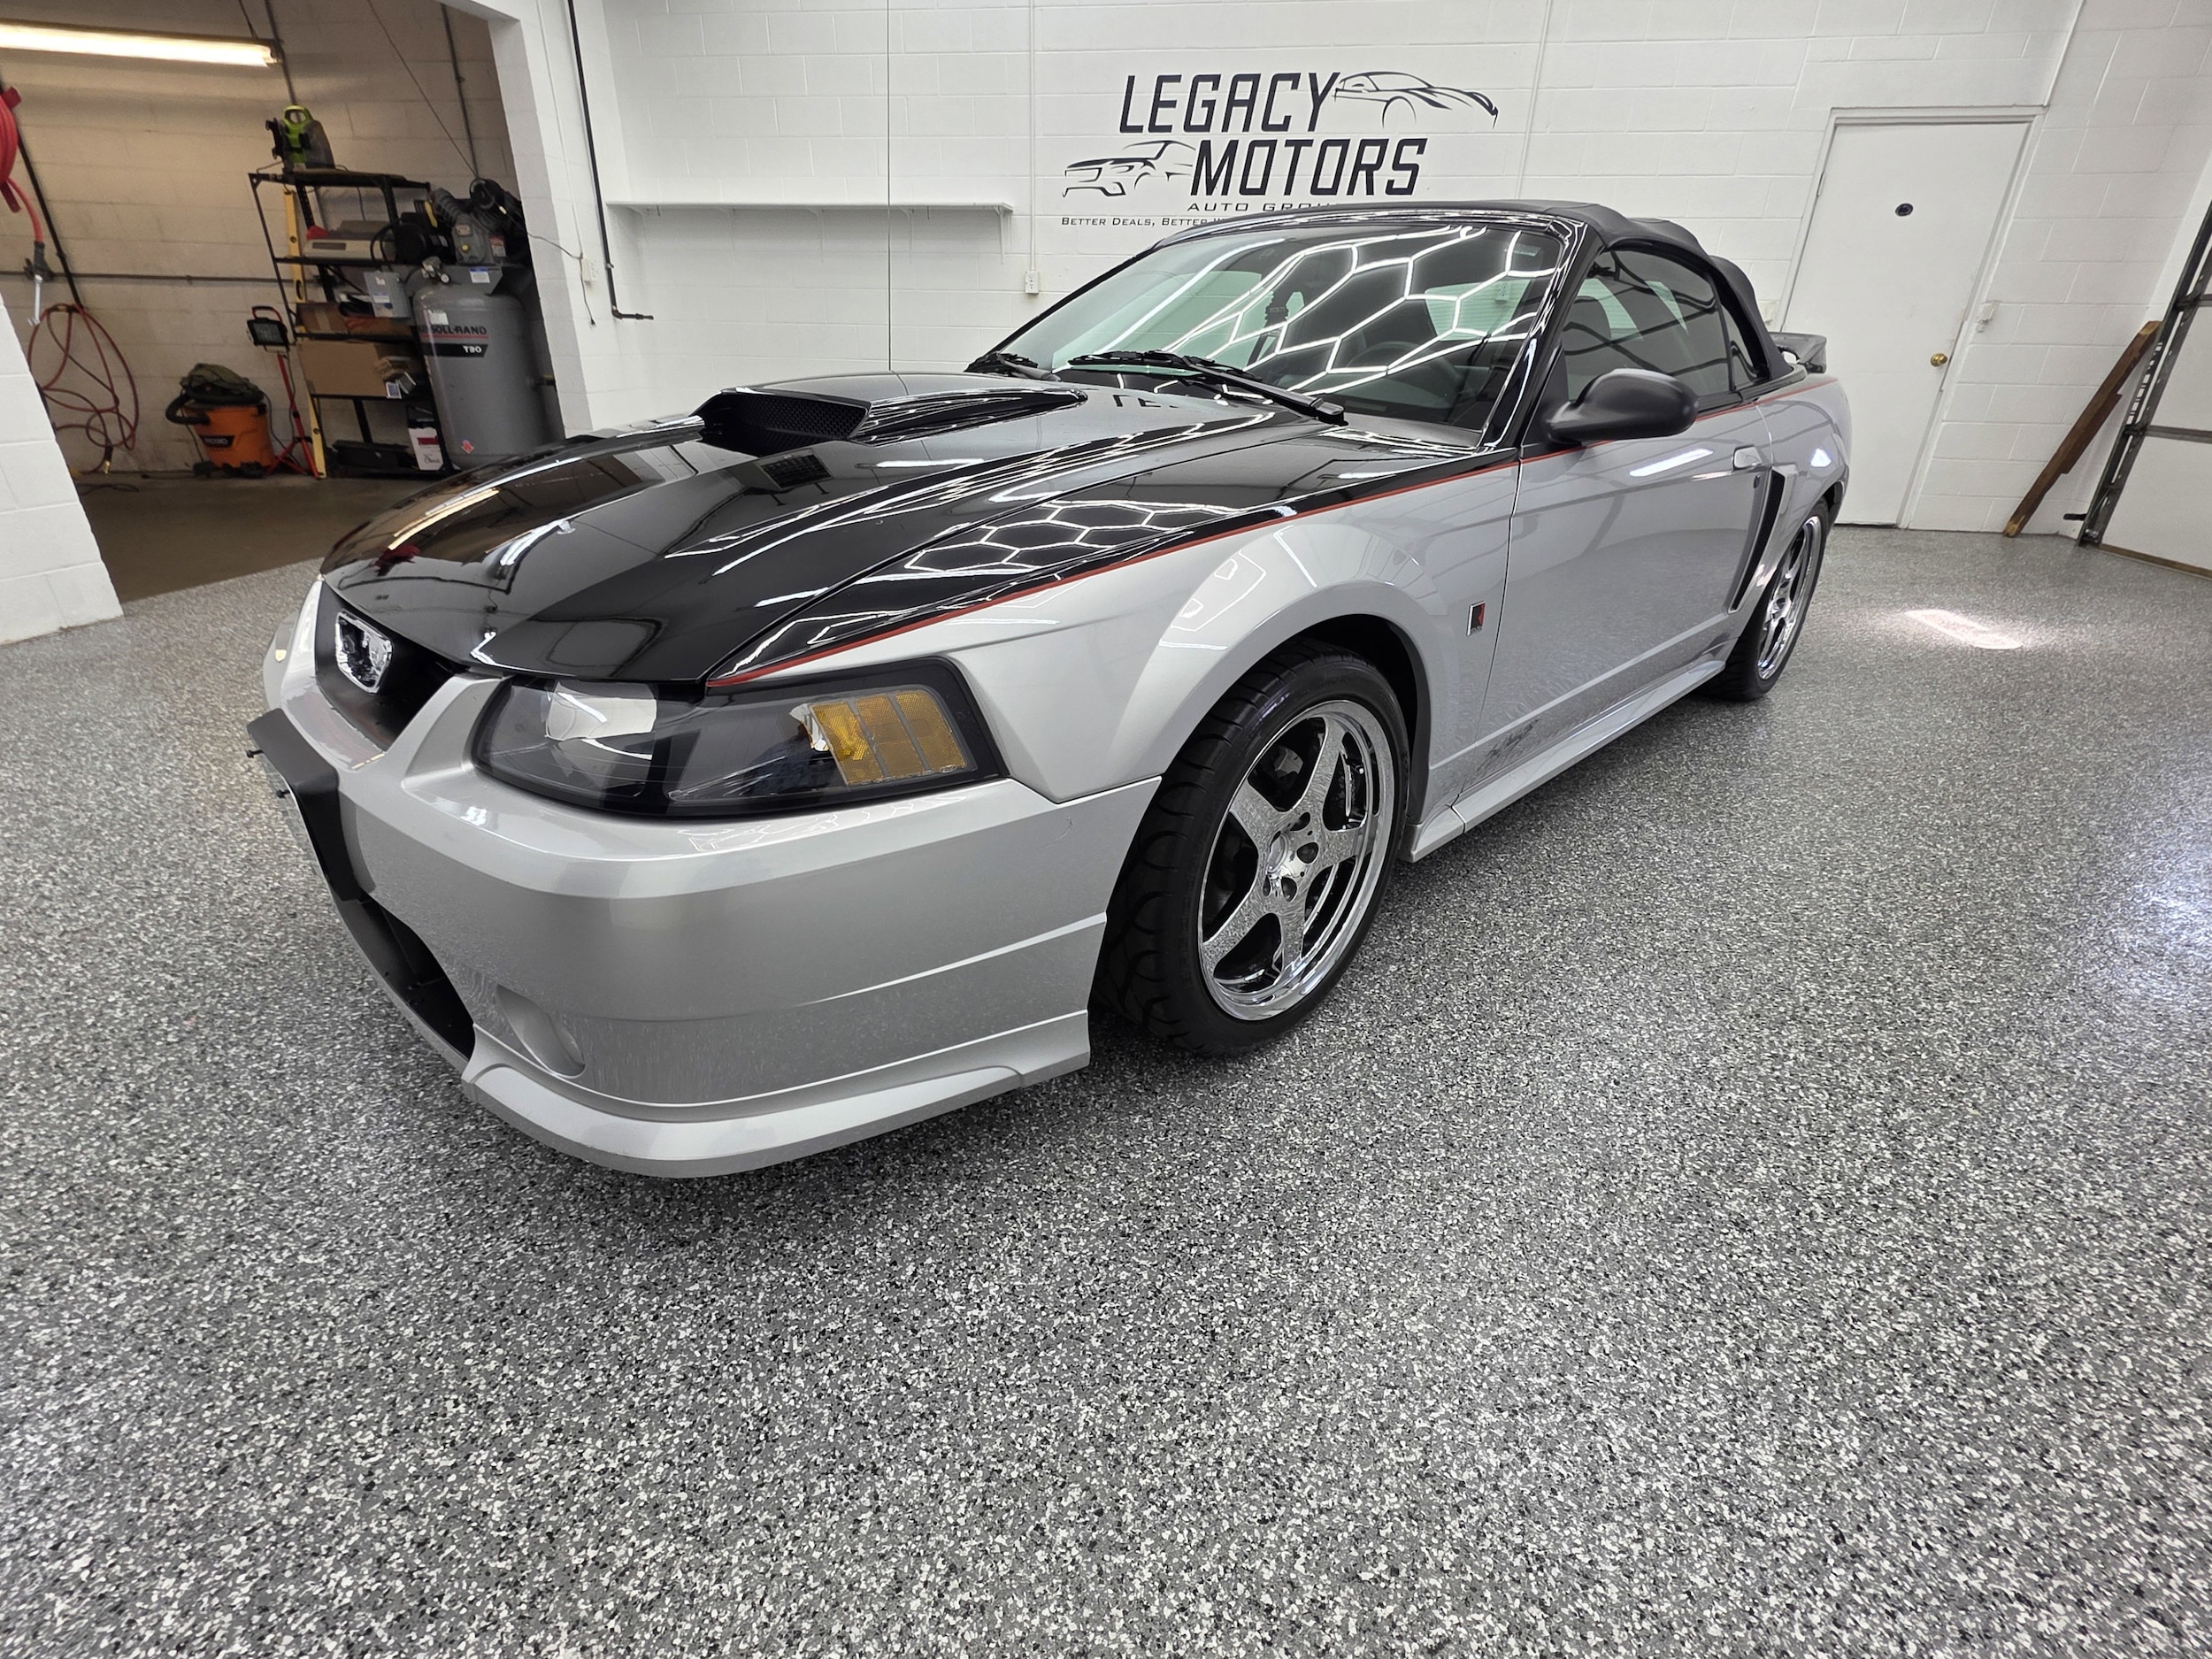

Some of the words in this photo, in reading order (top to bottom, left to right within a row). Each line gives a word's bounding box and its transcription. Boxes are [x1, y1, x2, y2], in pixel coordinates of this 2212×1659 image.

[1119, 72, 1340, 134] LEGACY
[1190, 137, 1428, 196] MOTORS
[1187, 203, 1249, 211] AUTO
[1263, 203, 1332, 211] GRO
